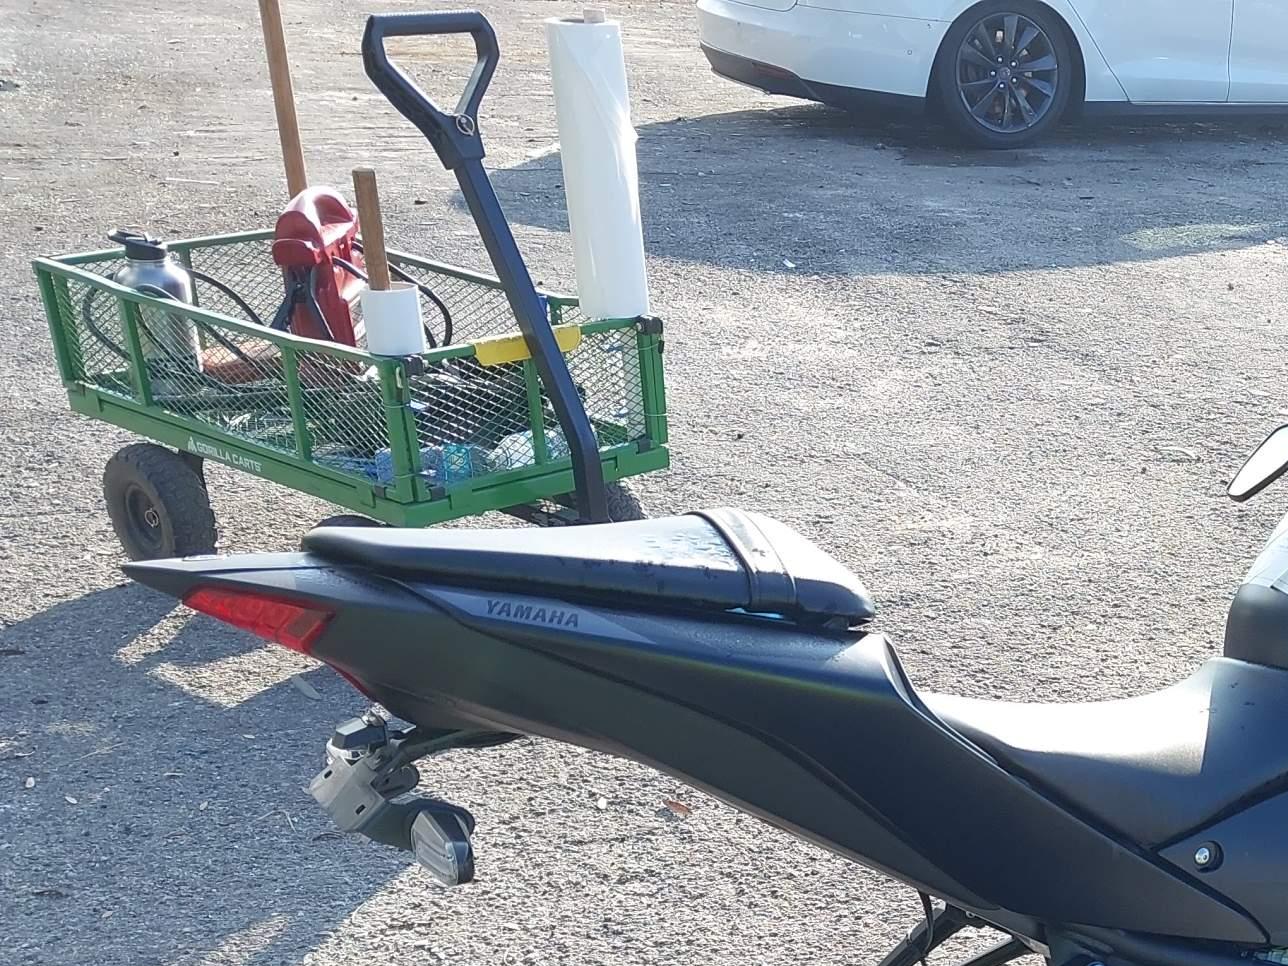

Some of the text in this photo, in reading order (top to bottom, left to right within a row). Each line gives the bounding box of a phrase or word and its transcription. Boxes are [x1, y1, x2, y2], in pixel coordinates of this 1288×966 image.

[196, 441, 261, 473] GORILLA CARTS
[486, 599, 580, 629] YAMAHA
